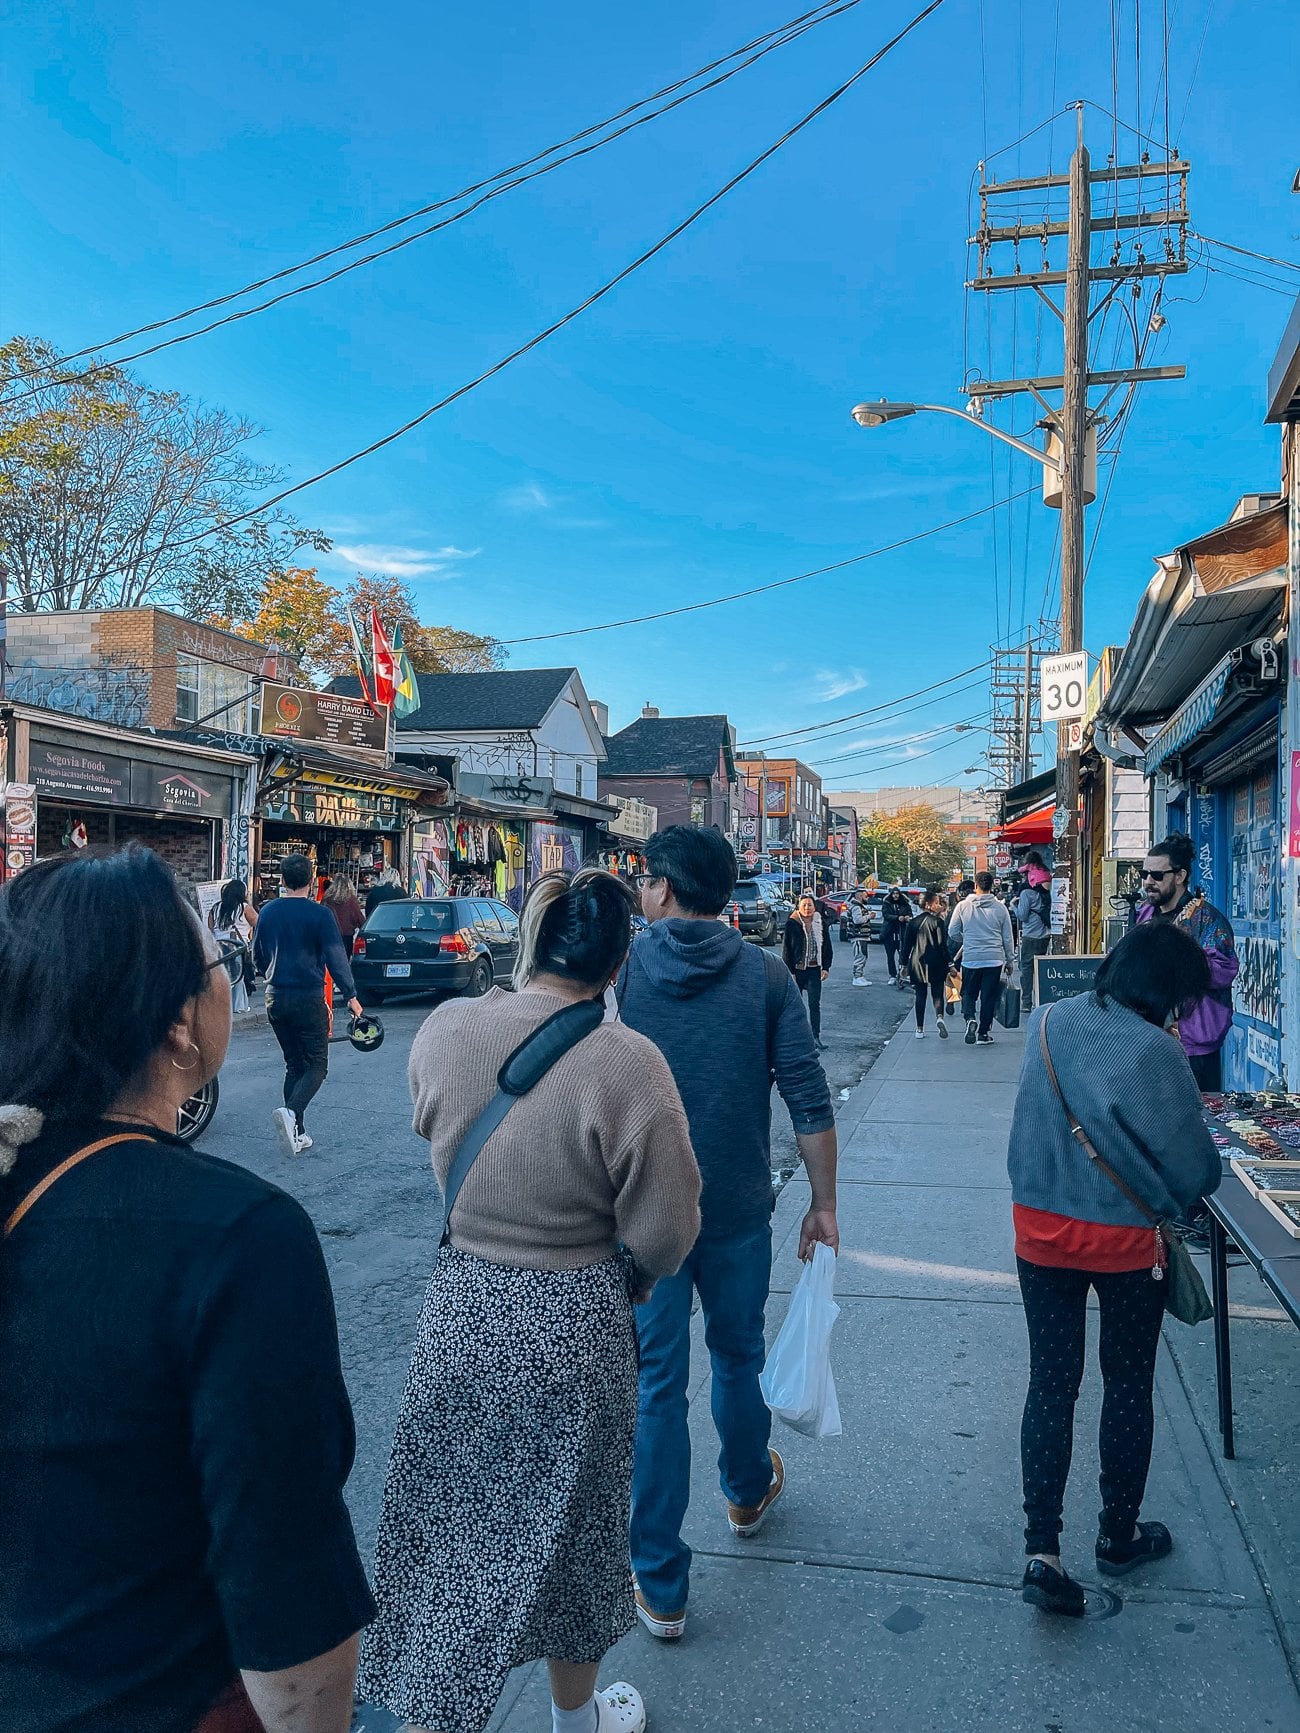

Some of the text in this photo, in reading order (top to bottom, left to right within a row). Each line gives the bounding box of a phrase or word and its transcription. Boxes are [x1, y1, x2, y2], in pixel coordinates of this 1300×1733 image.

[1045, 660, 1083, 676] MAXIMUM
[1047, 680, 1082, 711] 30
[317, 700, 341, 711] HARRY
[341, 703, 362, 715] DAVID
[362, 707, 375, 717] LTD
[46, 751, 106, 773] Segovia Foods
[45, 778, 65, 789] Augusta
[65, 781, 82, 790] Avenue
[165, 783, 196, 798] Segovia
[333, 774, 389, 791] DAVID
[543, 846, 561, 869] TAP
[994, 856, 1010, 865] STOP
[1047, 967, 1063, 979] We
